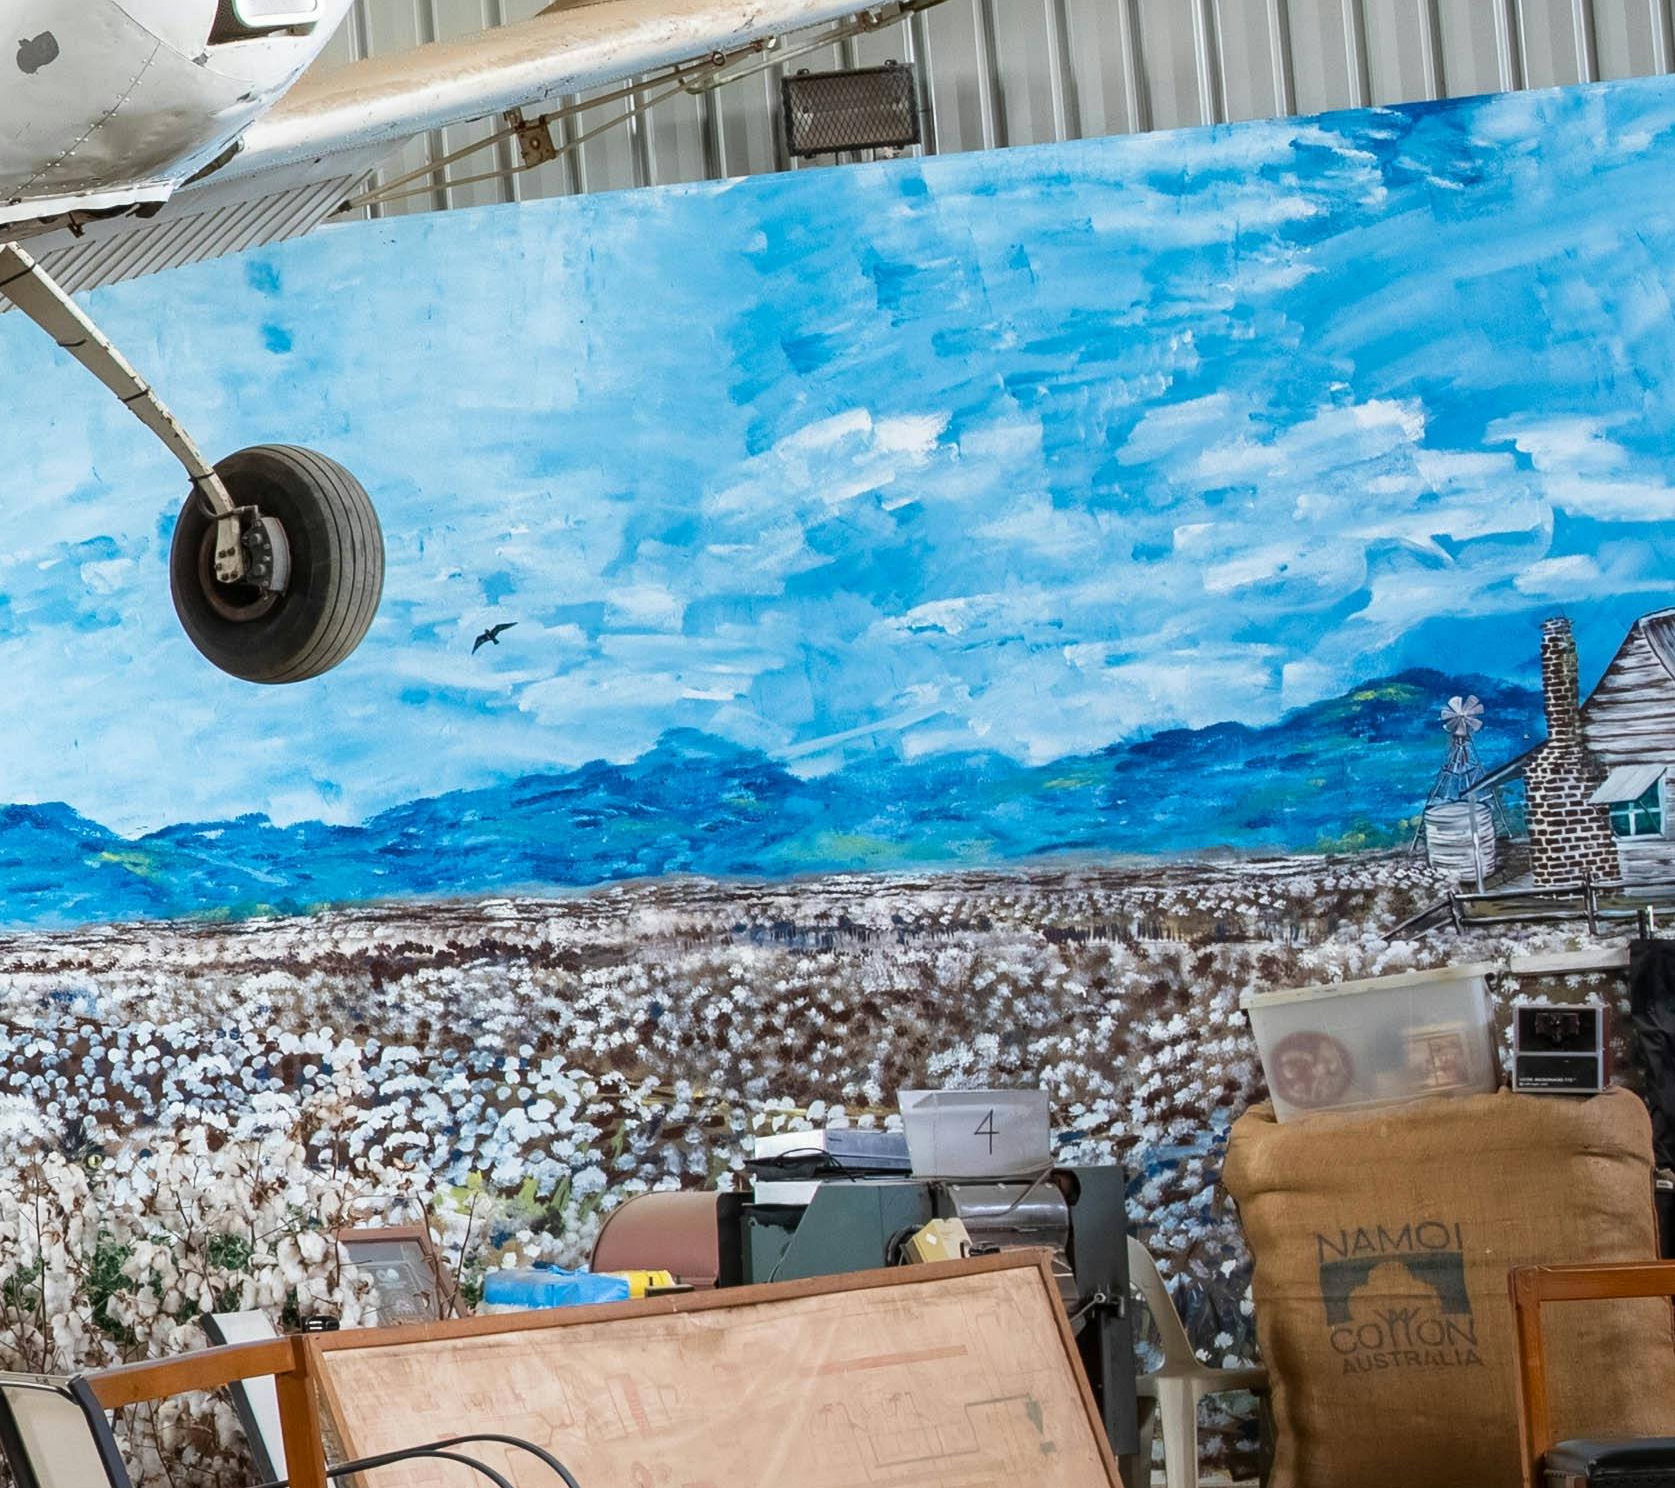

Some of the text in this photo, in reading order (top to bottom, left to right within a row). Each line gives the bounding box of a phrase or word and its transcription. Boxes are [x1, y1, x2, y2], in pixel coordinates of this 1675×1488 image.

[973, 1108, 1000, 1156] 4
[1314, 1220, 1464, 1264] NAMOI
[1330, 1306, 1479, 1355] COTTON
[1342, 1349, 1486, 1376] AUSTRALIA
